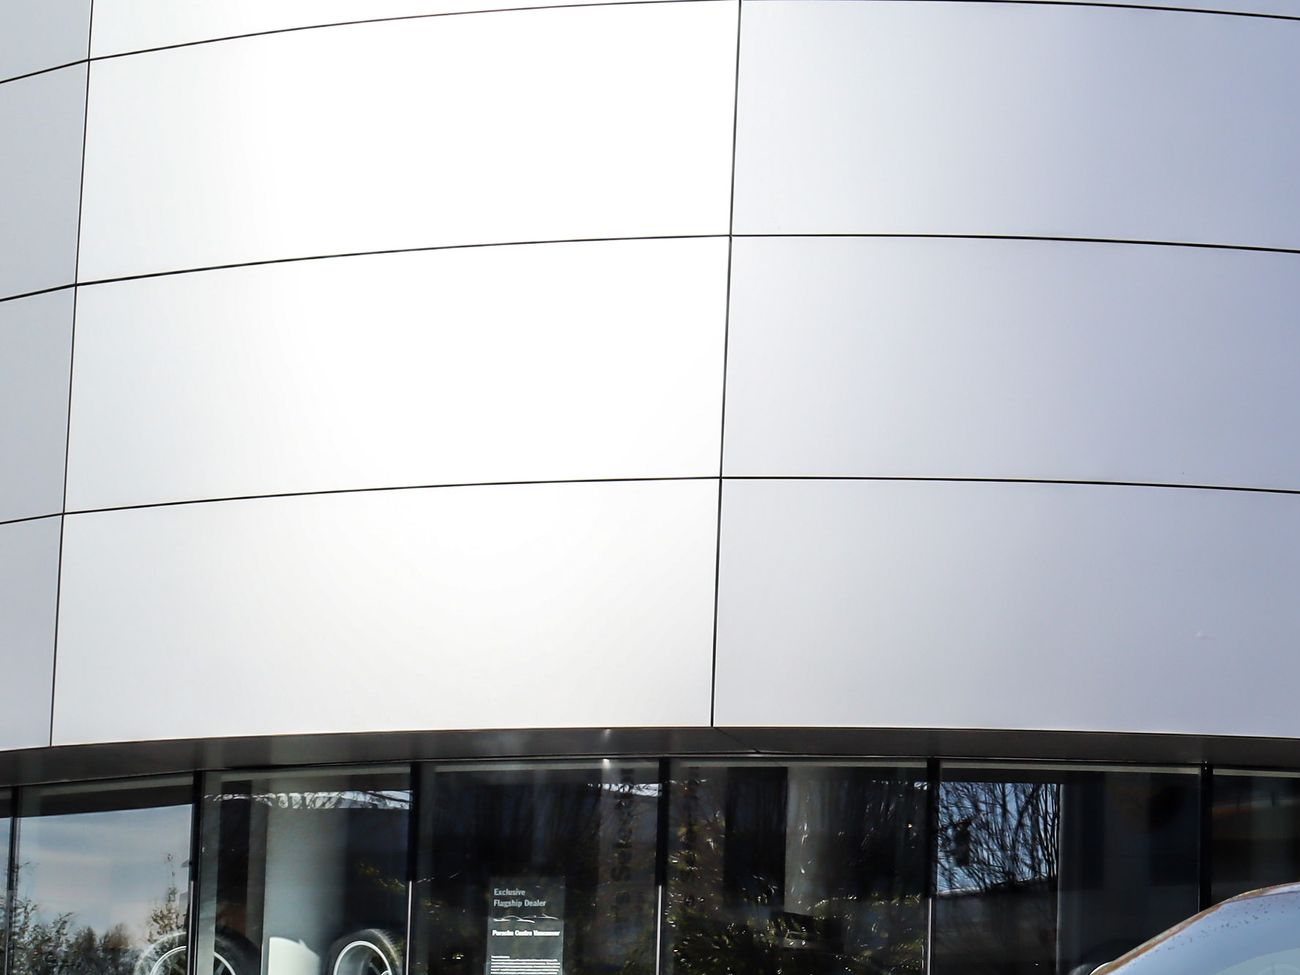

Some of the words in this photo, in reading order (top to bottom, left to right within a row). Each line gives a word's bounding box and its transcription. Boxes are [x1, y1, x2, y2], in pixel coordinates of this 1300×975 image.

[493, 888, 526, 896] Exclusive
[493, 899, 523, 908] Flagship
[524, 899, 547, 907] Dealer
